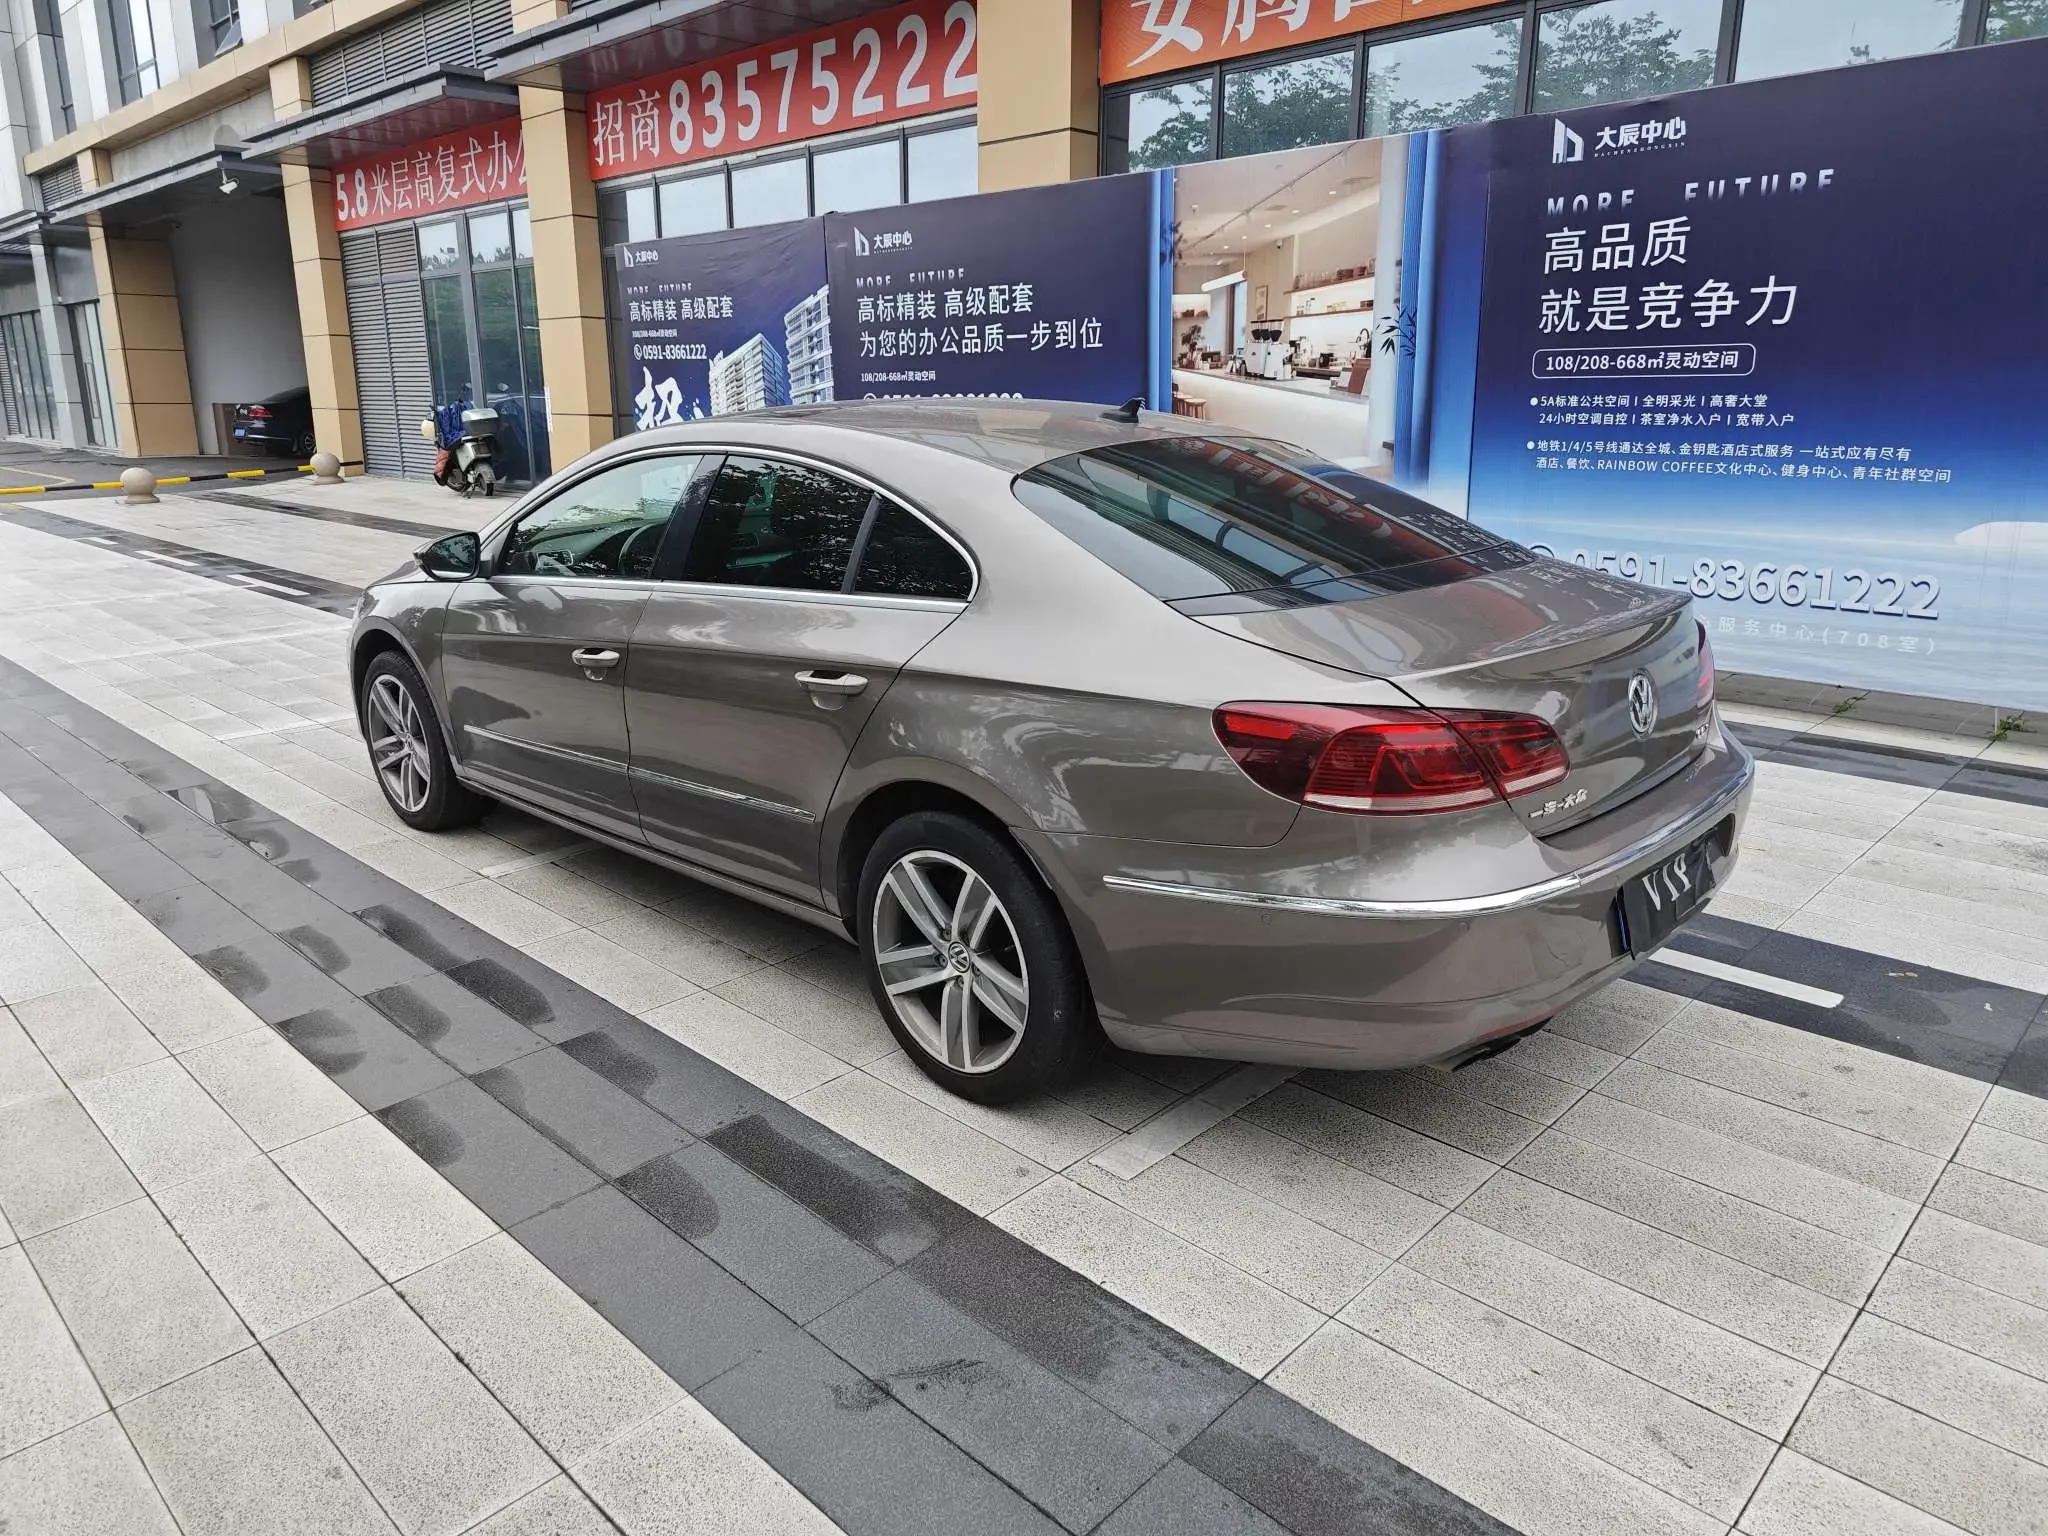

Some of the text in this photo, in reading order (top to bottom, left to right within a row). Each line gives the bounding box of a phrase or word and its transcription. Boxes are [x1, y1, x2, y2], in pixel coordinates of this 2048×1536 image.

[1594, 116, 1687, 151] 大辰中心
[1543, 215, 1691, 274] 高品质
[628, 294, 734, 322] 高标精装 高级配套
[857, 281, 1034, 324] 高标精装 高级配套
[1538, 275, 1798, 334] 就是竞争力
[642, 343, 708, 360] 0591-83661222
[859, 317, 1103, 358] 为您的办公品质一步到位
[1540, 395, 1630, 408] 5A标准公共空间
[1642, 394, 1696, 408] 全明采光
[1539, 412, 1794, 428] 24小时空调自控 茶室净水入户 宽带入户
